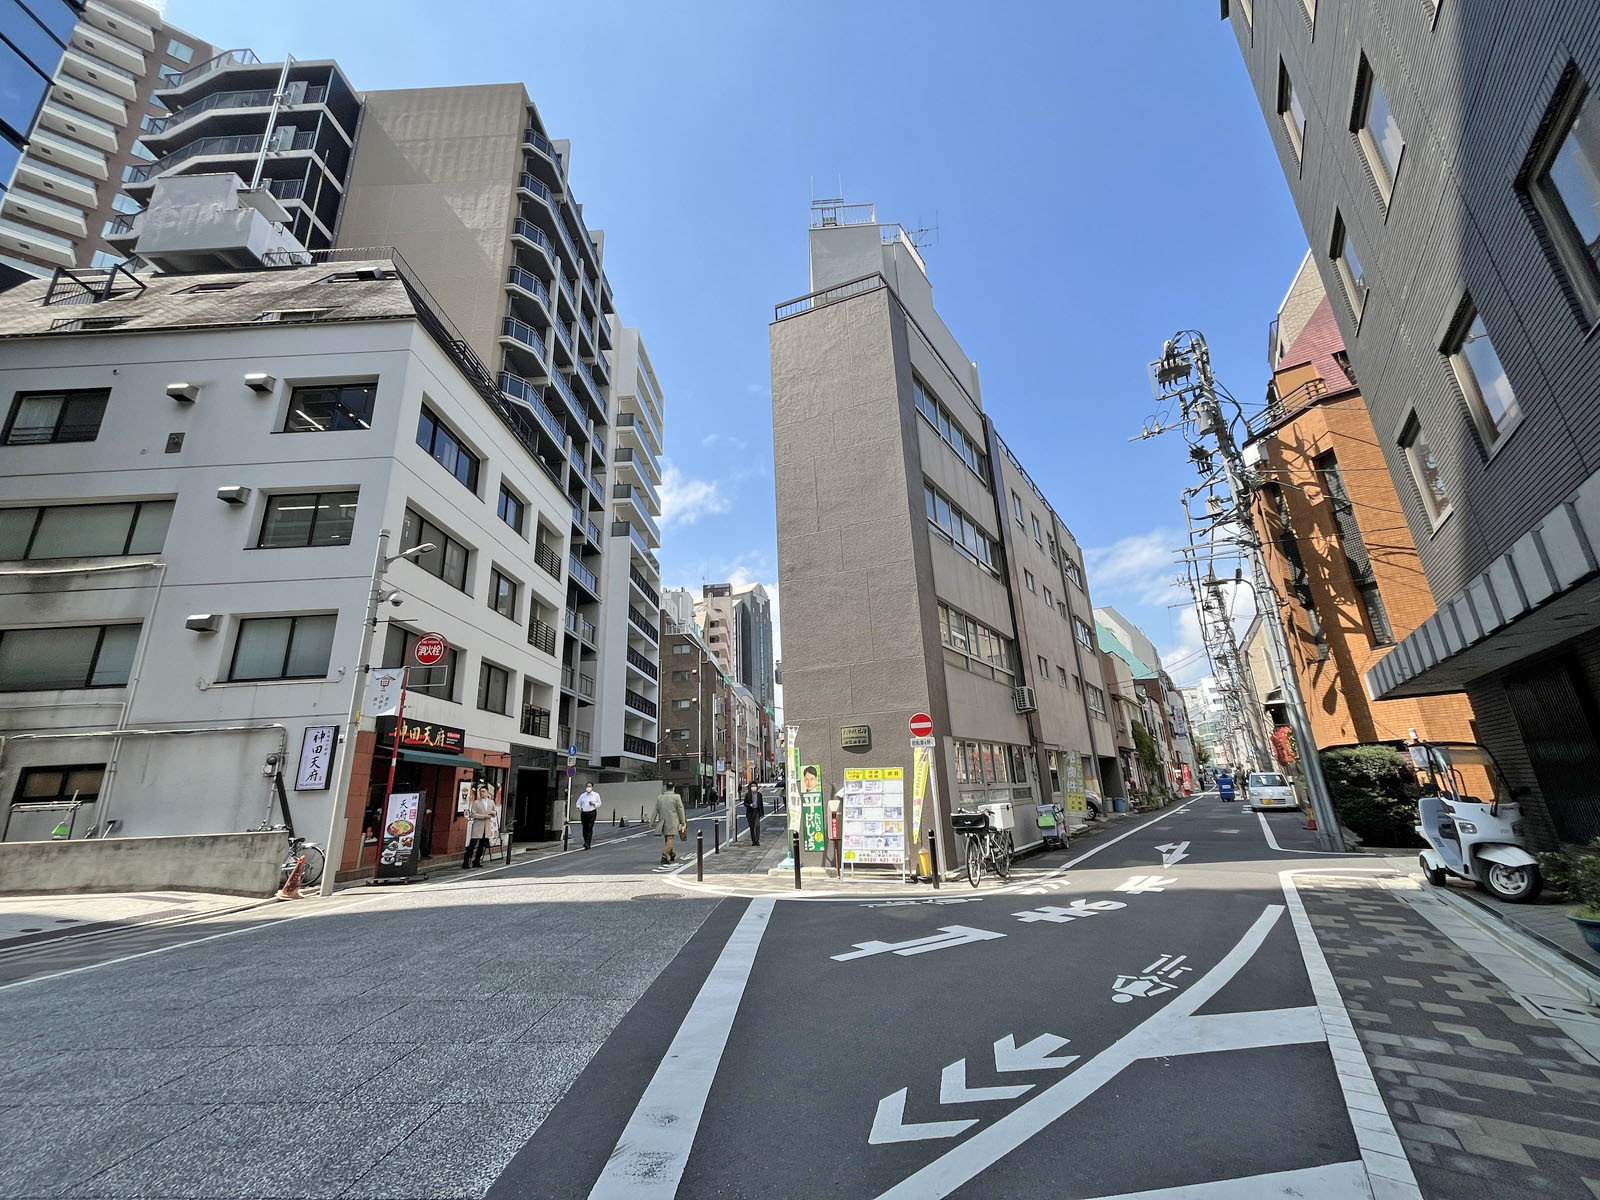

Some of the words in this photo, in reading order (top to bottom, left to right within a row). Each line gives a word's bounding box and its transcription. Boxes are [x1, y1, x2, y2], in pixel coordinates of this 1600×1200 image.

[418, 645, 442, 656] 消火栓
[394, 720, 446, 747] 神田天府
[305, 730, 326, 782] 神田天府
